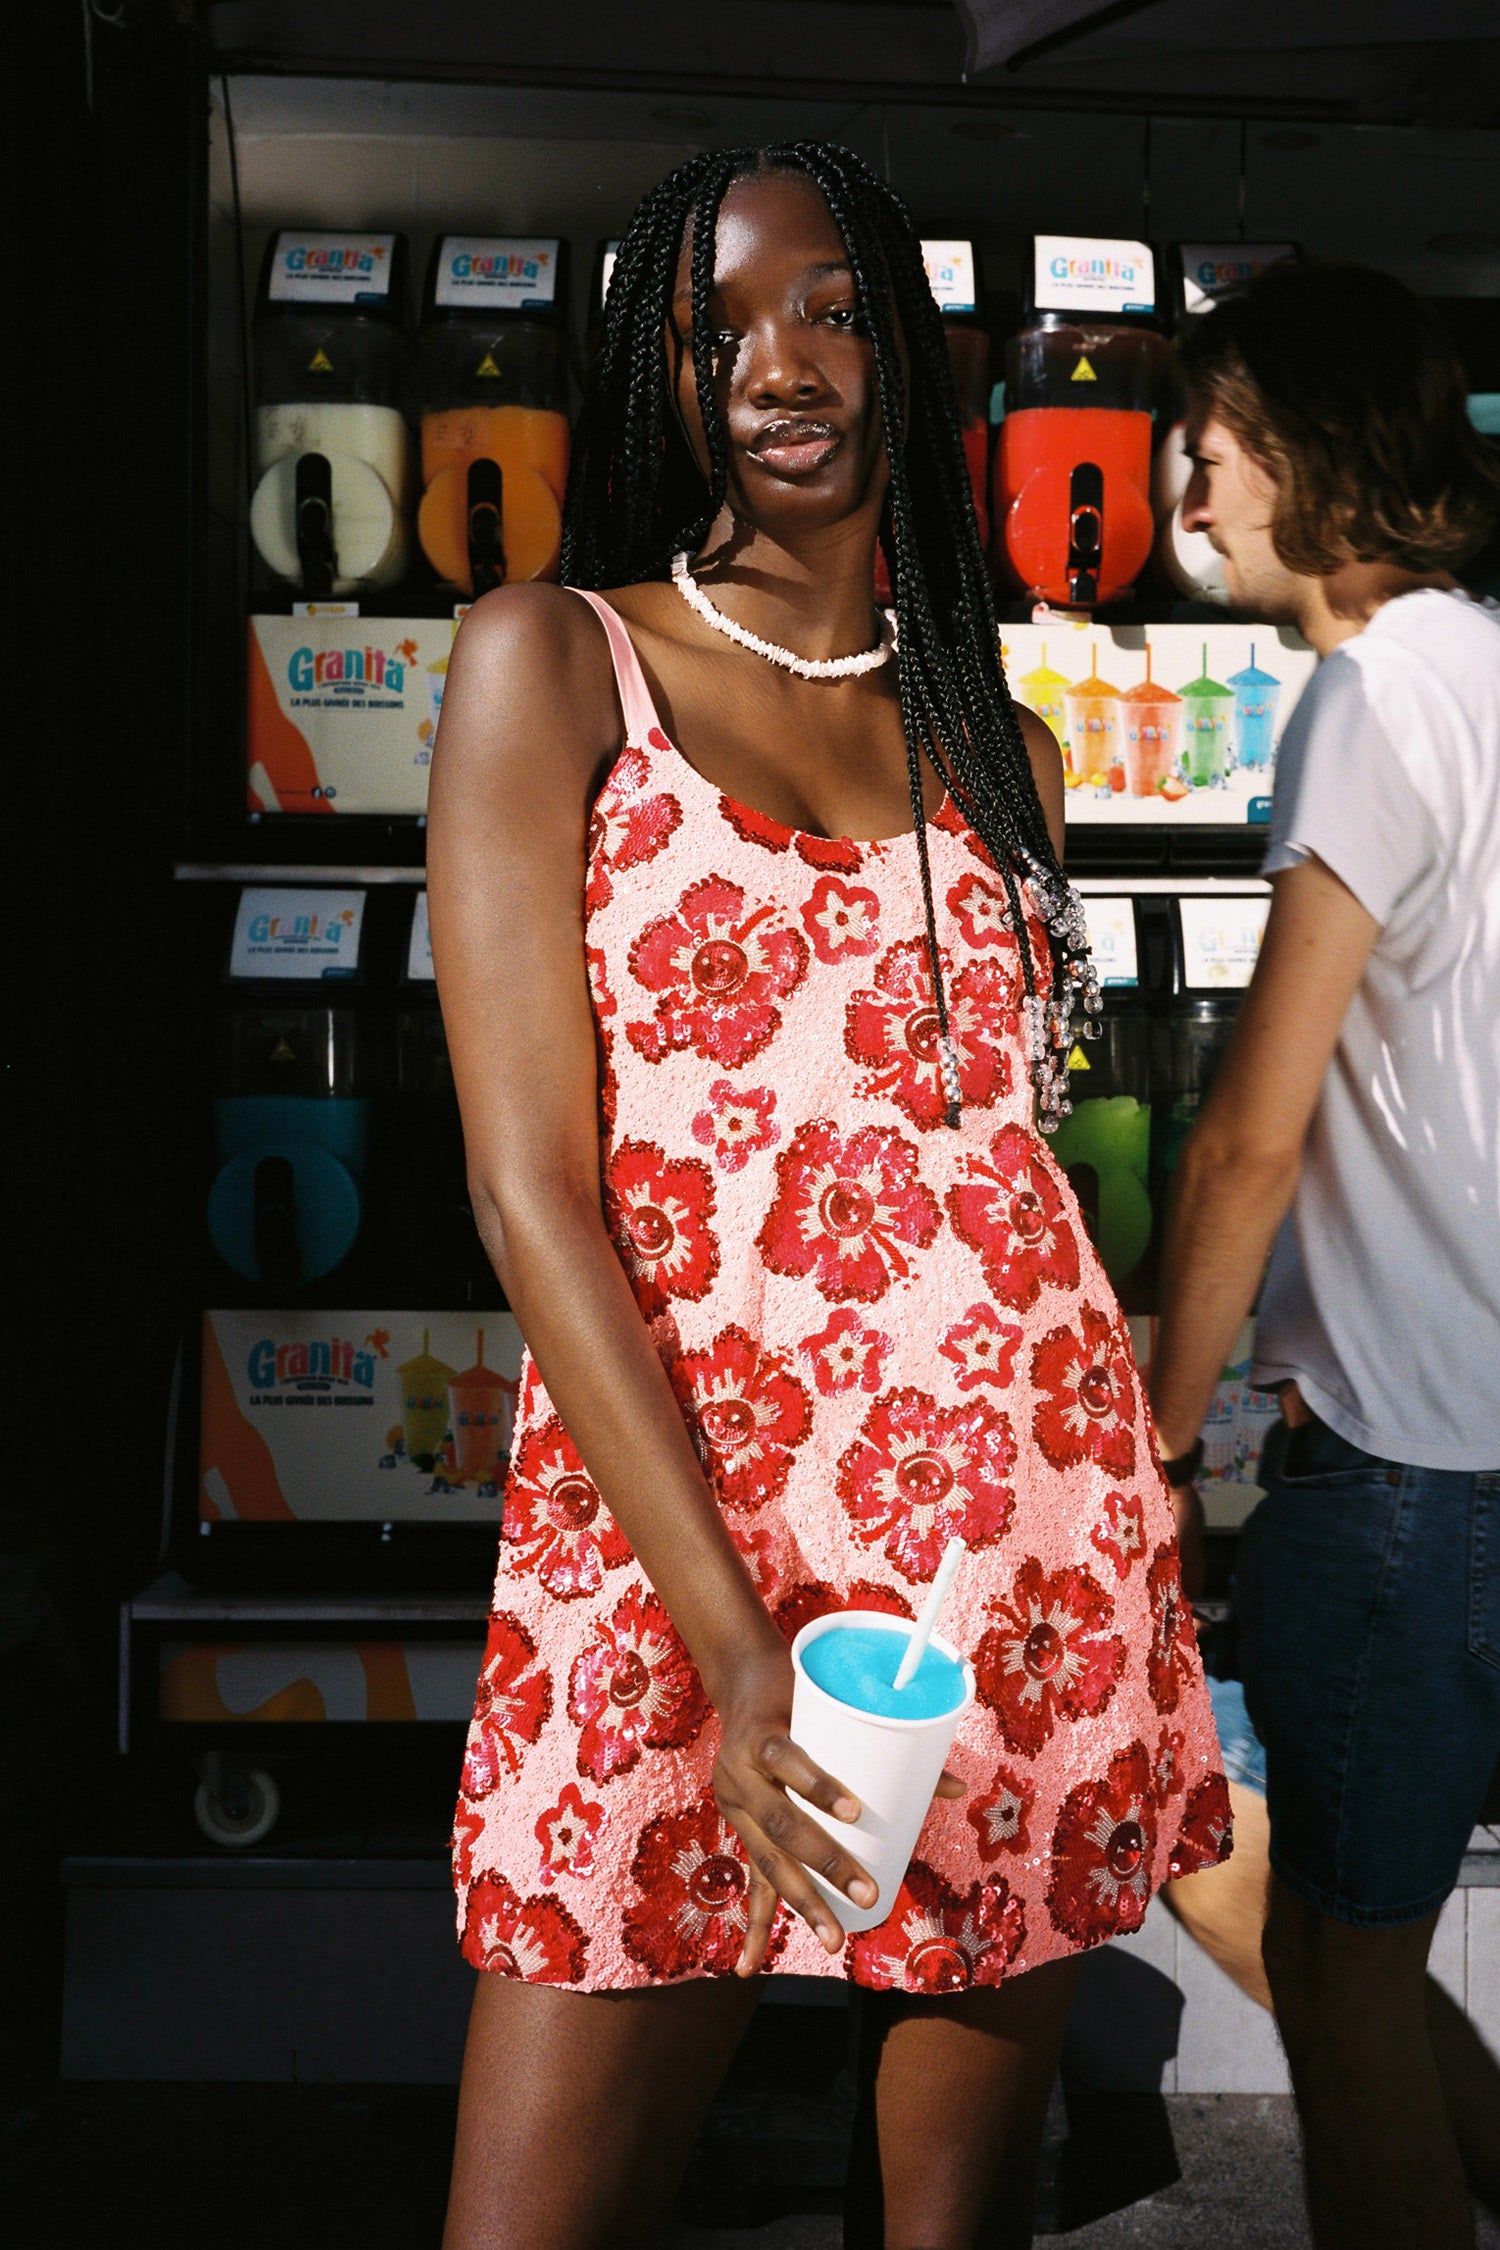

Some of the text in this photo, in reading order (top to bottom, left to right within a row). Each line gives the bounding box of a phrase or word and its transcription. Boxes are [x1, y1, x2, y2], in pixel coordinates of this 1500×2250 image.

[285, 247, 373, 272] Granita
[452, 254, 538, 279] Granita
[1050, 257, 1134, 282] Granita
[288, 646, 404, 693] Granita
[248, 1337, 375, 1389] Granita
